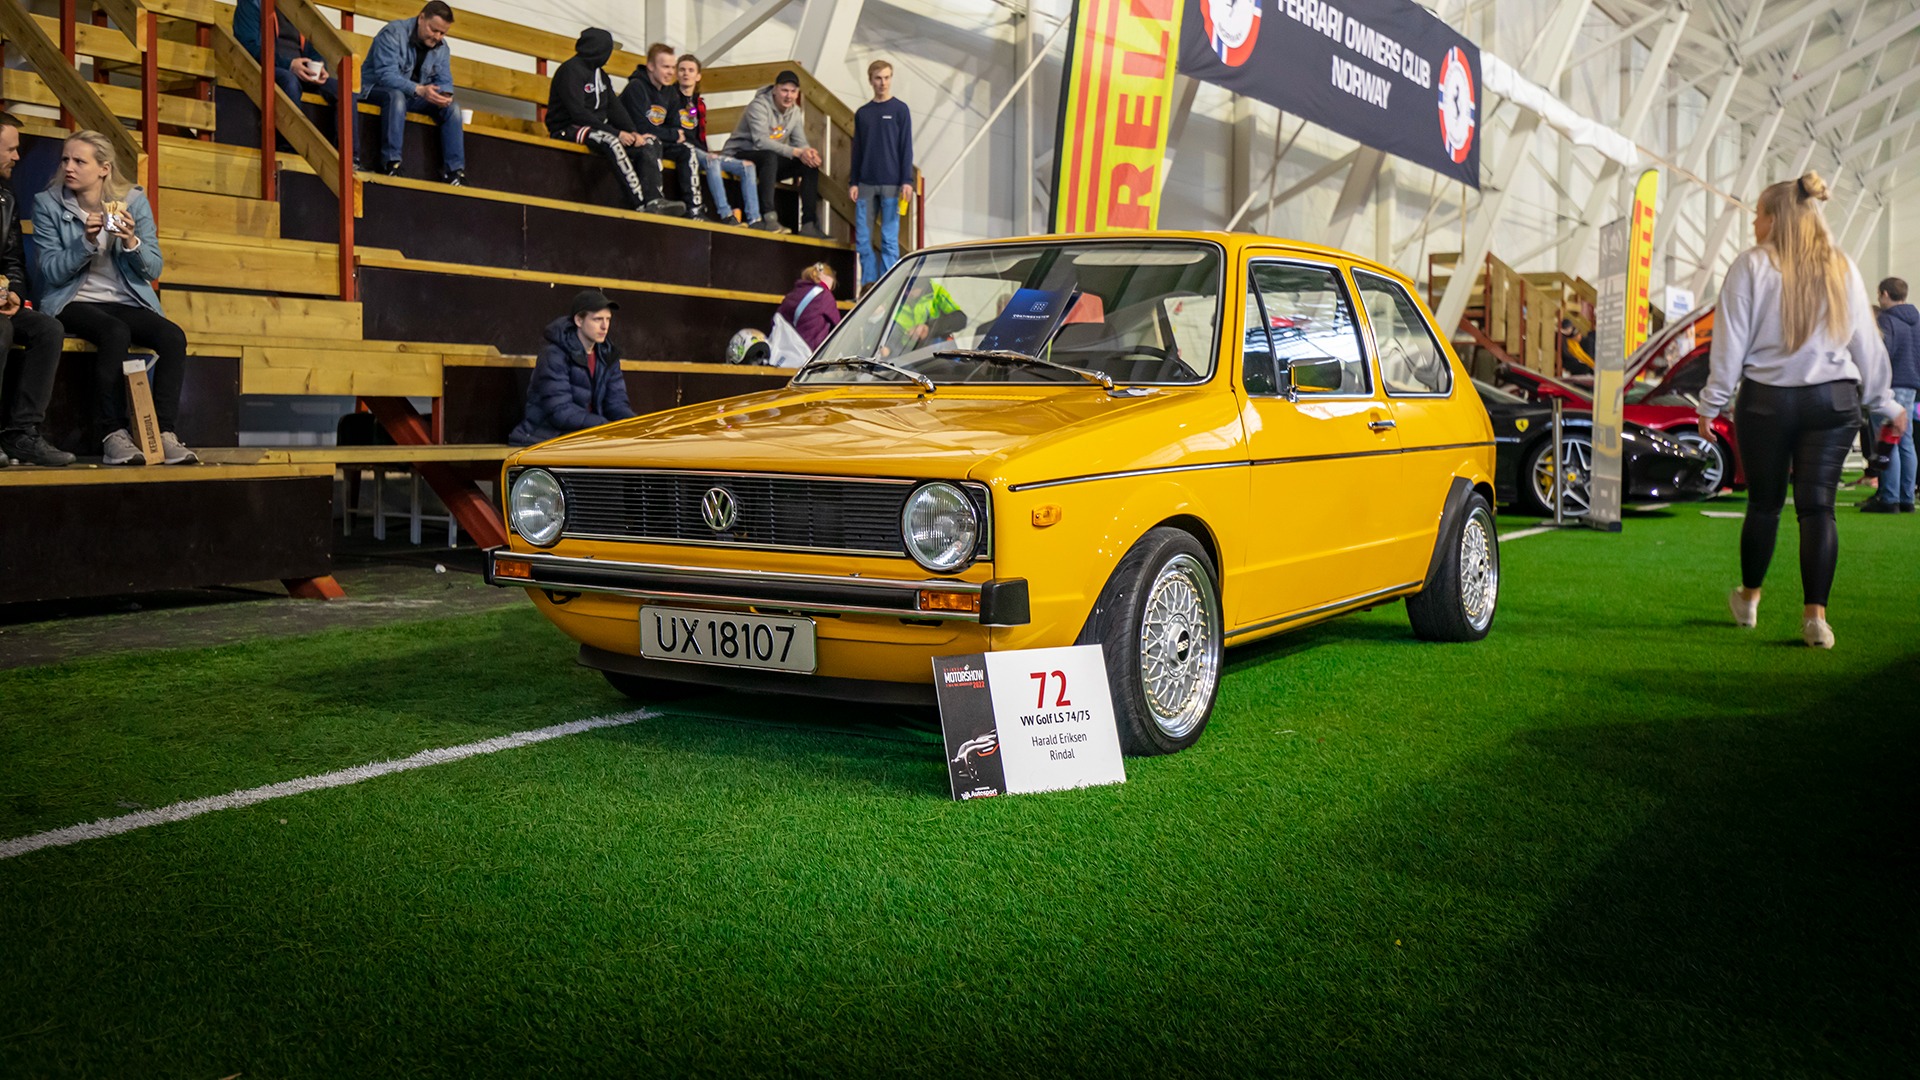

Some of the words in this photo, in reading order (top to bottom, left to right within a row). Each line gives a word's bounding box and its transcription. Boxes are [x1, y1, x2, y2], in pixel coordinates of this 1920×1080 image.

[1344, 17, 1402, 73] OWNERS
[1402, 48, 1431, 90] CLUB
[1331, 54, 1392, 110] NORWAY
[656, 615, 702, 654] UX
[708, 620, 795, 662] 18107
[944, 669, 984, 683] MOTORSHOW
[1030, 670, 1071, 709] 72
[1020, 715, 1034, 726] VW
[1036, 714, 1053, 725] Golf
[1053, 712, 1065, 723] LS
[1065, 710, 1090, 723] 74/75
[1032, 734, 1058, 747] Harald
[1059, 733, 1088, 744] Eriksen
[1050, 748, 1076, 761] Rindal
